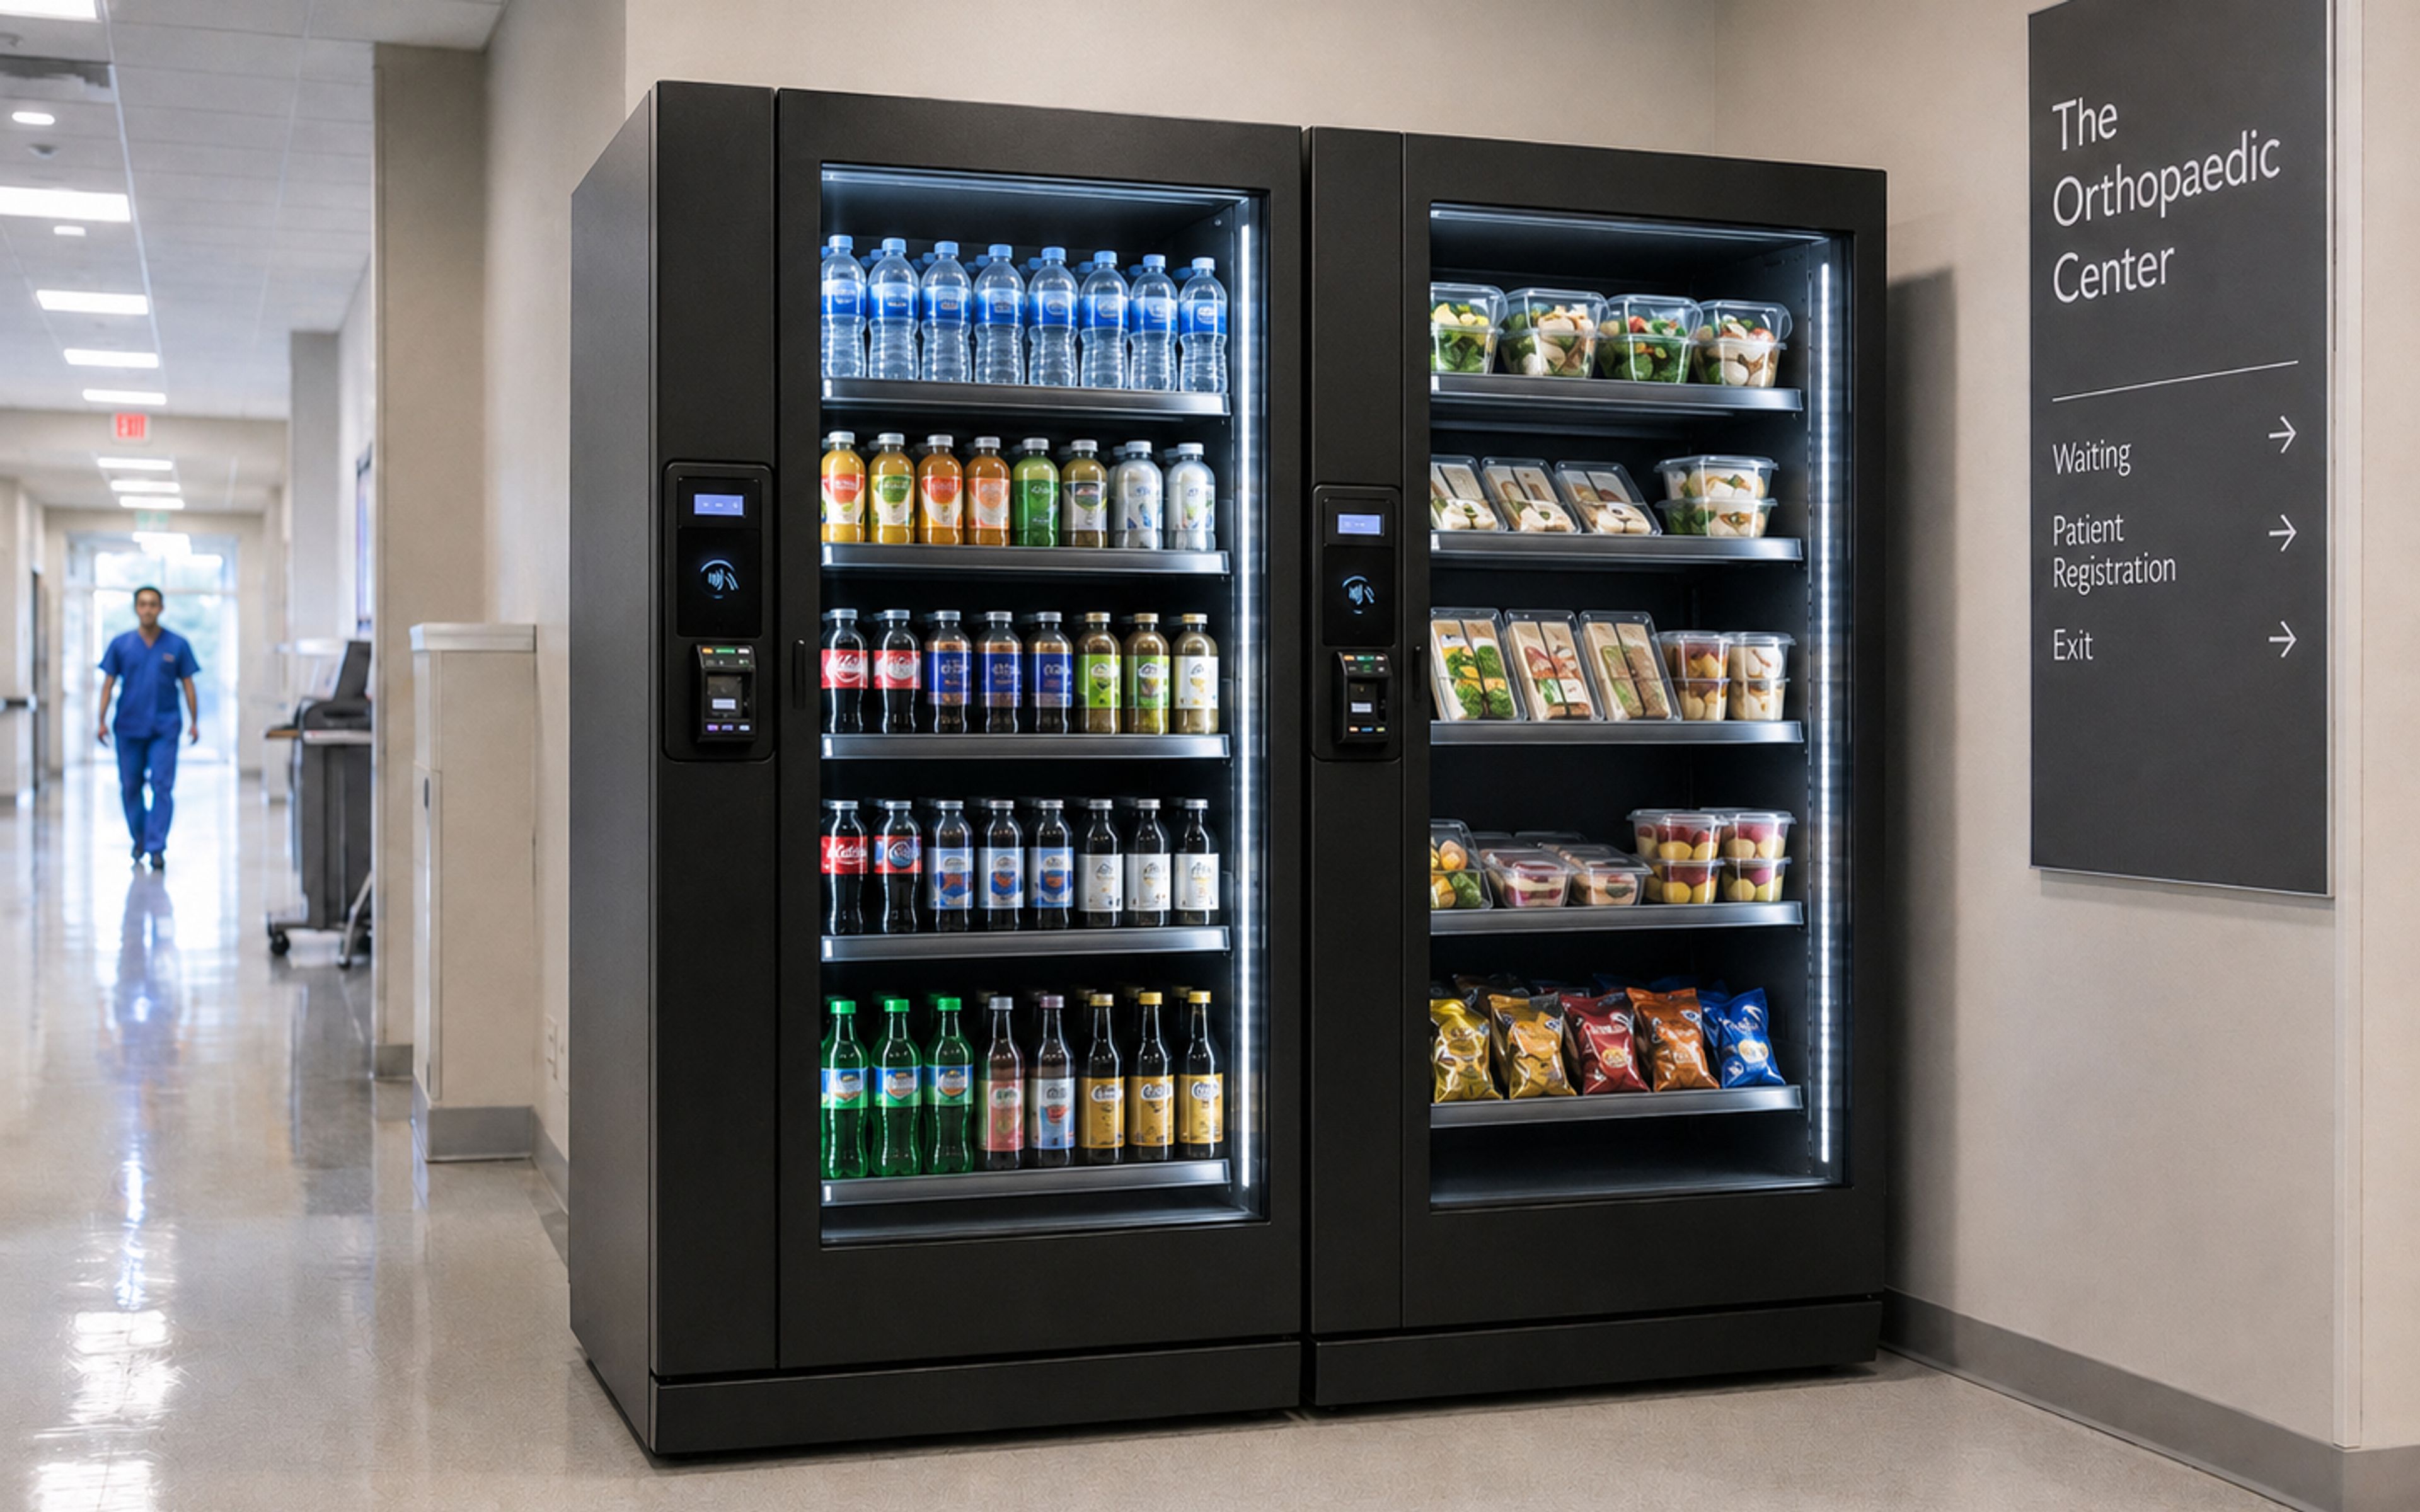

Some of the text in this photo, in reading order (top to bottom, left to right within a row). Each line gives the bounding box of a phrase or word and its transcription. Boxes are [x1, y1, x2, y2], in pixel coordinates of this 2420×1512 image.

[2051, 96, 2118, 151] The
[2053, 129, 2281, 227] Orthopaedic
[2053, 246, 2175, 303] Center
[116, 413, 146, 437] EXIT
[2051, 438, 2131, 477] Waiting
[2053, 513, 2124, 546] Patient
[2053, 551, 2175, 595] Registration
[2053, 627, 2094, 660] Exit
